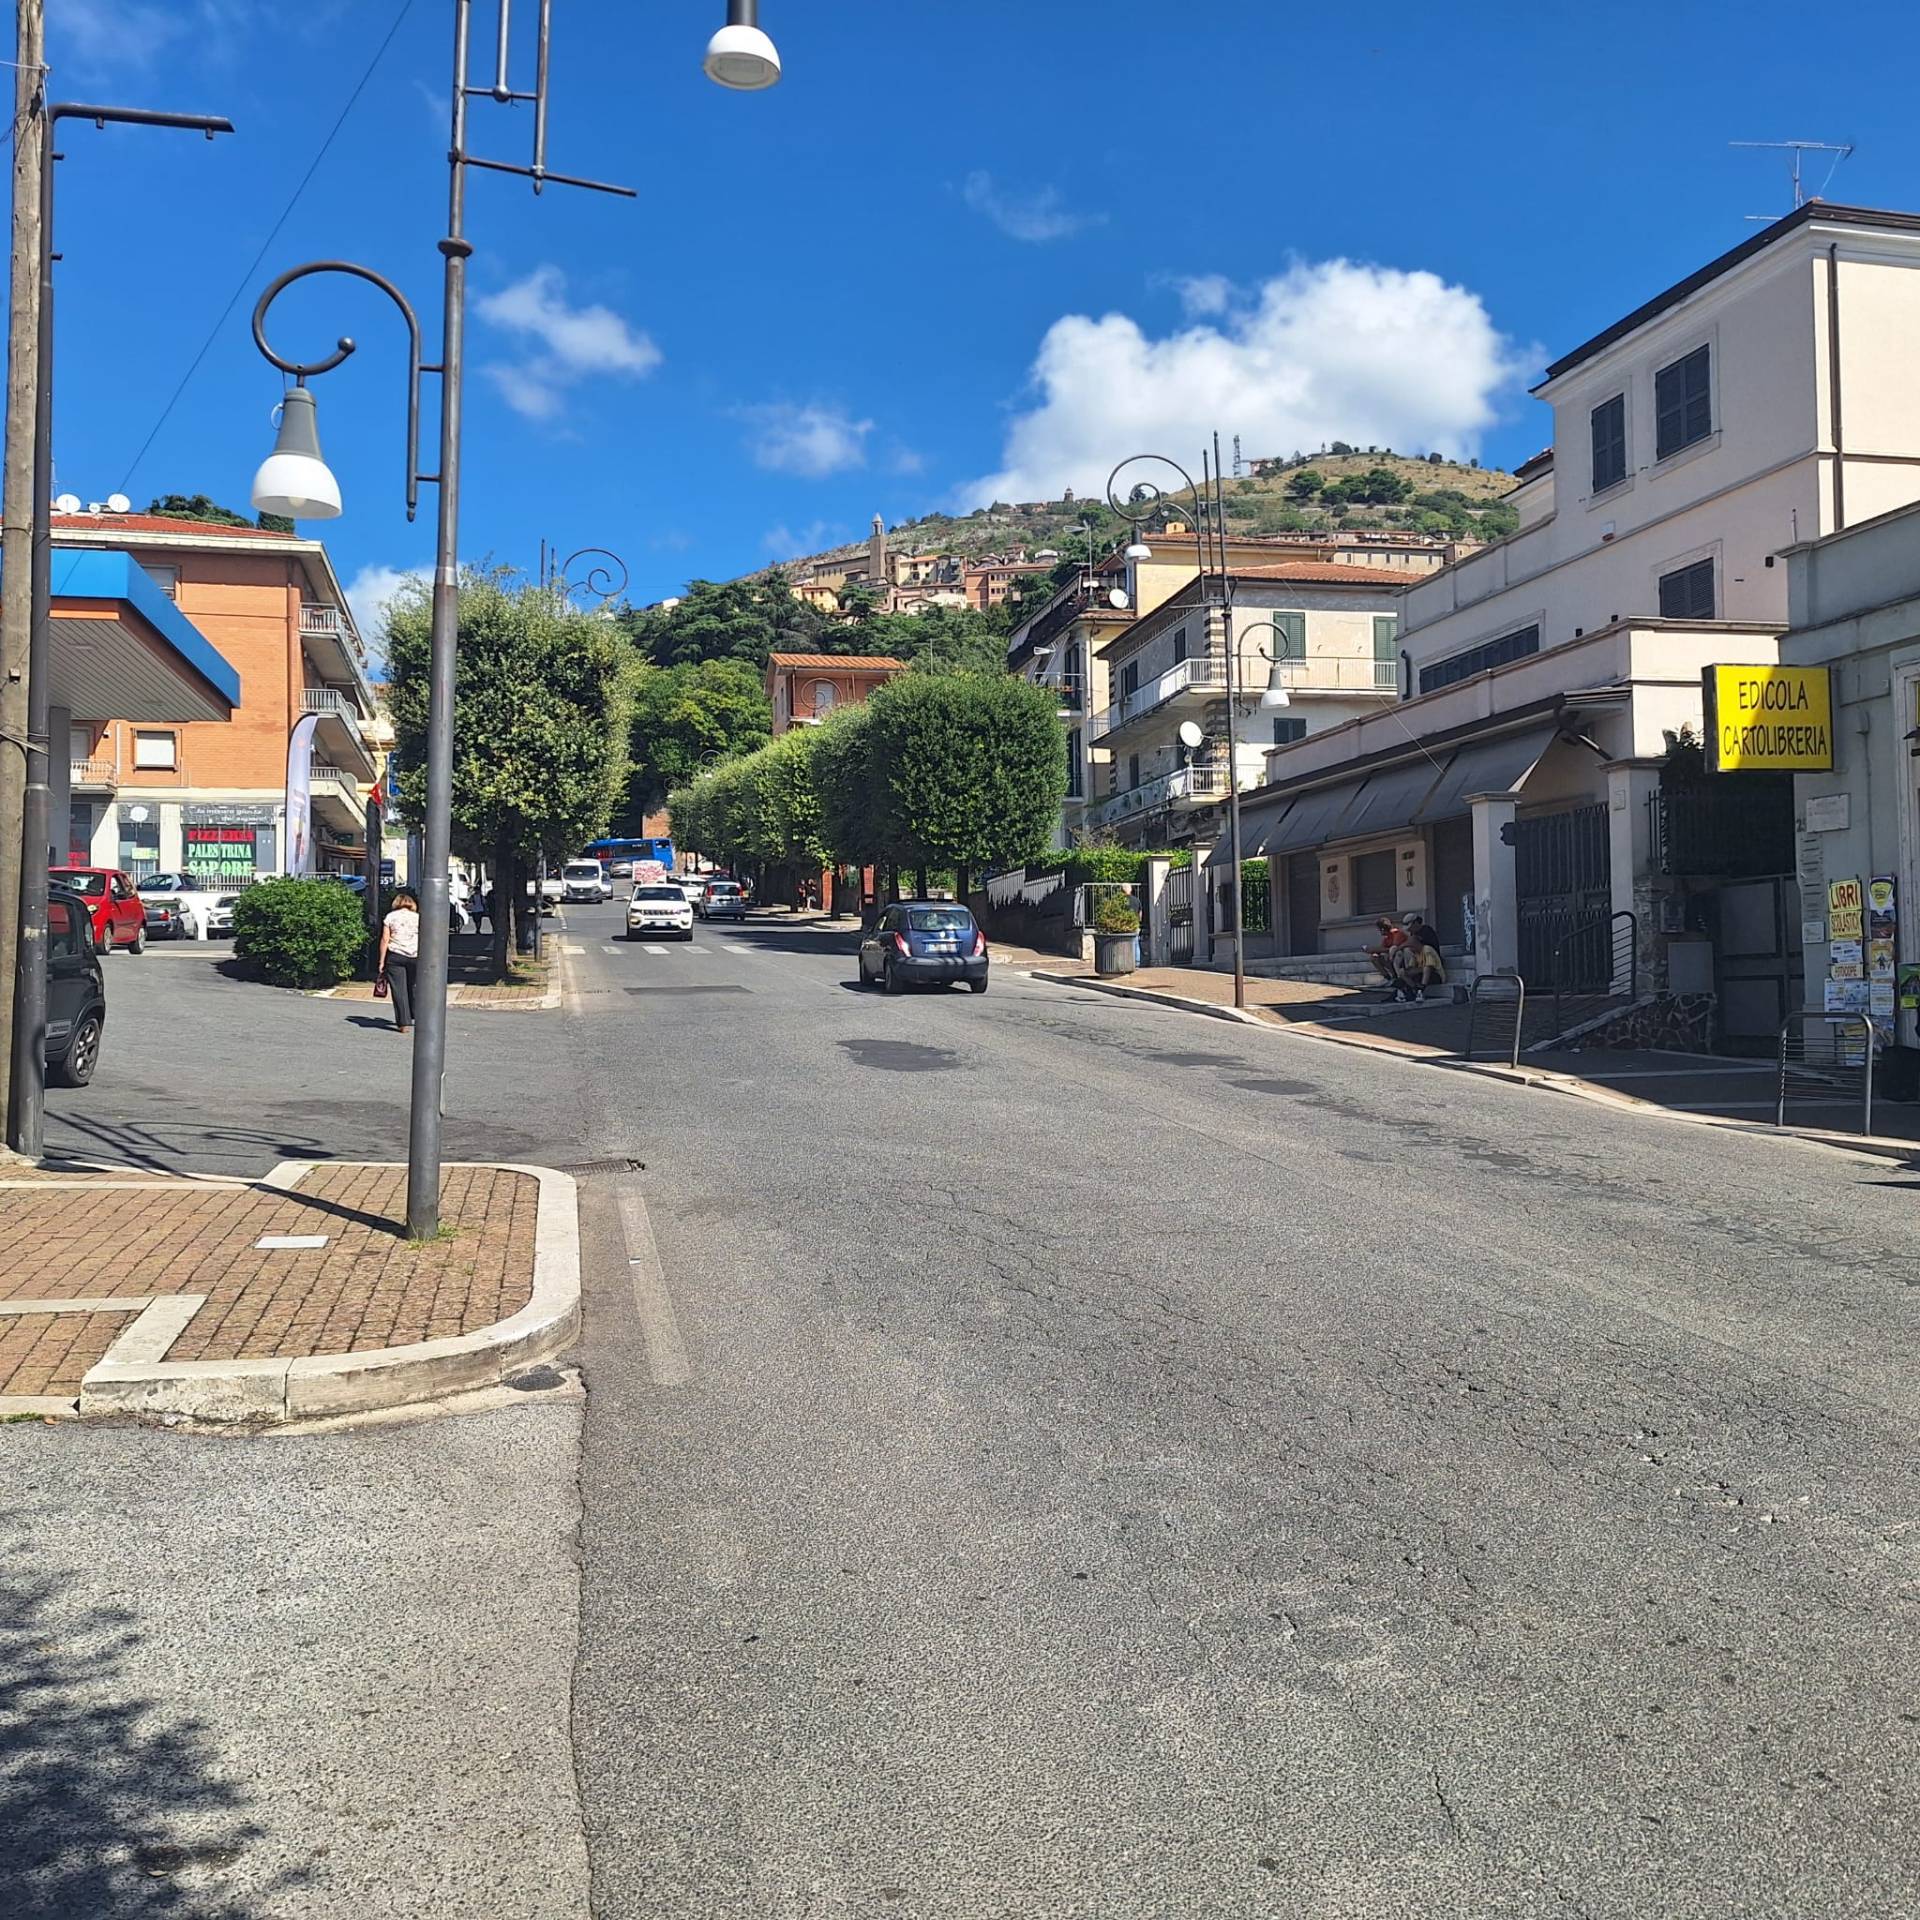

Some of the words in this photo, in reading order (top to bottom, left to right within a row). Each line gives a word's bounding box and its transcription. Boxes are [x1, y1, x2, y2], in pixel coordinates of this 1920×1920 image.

[1739, 680, 1808, 710] EDICOLA
[1723, 724, 1828, 756] CARTOLIBRERIA
[188, 843, 252, 858] PALESTRINA
[1830, 883, 1859, 910] LIBRI
